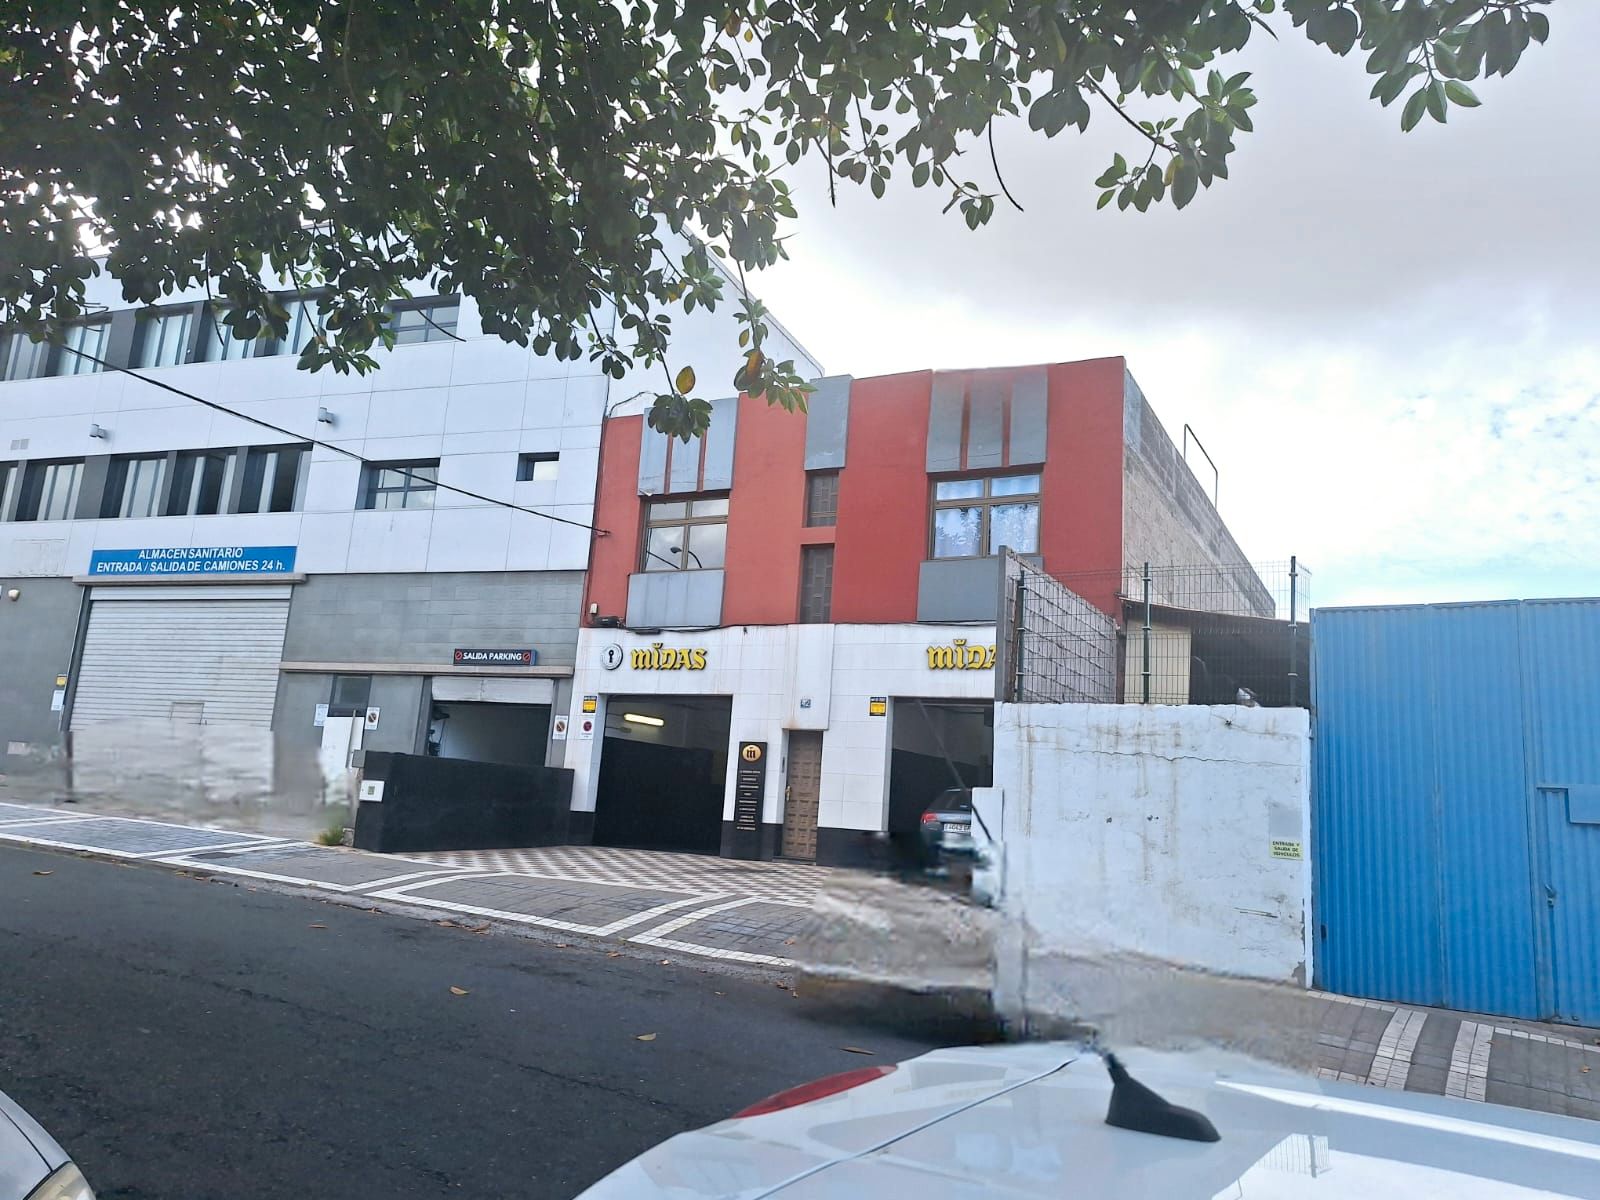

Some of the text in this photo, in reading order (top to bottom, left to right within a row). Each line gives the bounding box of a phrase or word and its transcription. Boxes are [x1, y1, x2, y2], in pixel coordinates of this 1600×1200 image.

[138, 547, 244, 560] ALMACEN SANITARIO
[96, 559, 286, 573] ENTRADA / SALIDA DE CAMIONES 24 h.
[462, 652, 522, 661] SALIDA PARKING
[927, 638, 997, 670] MIDA
